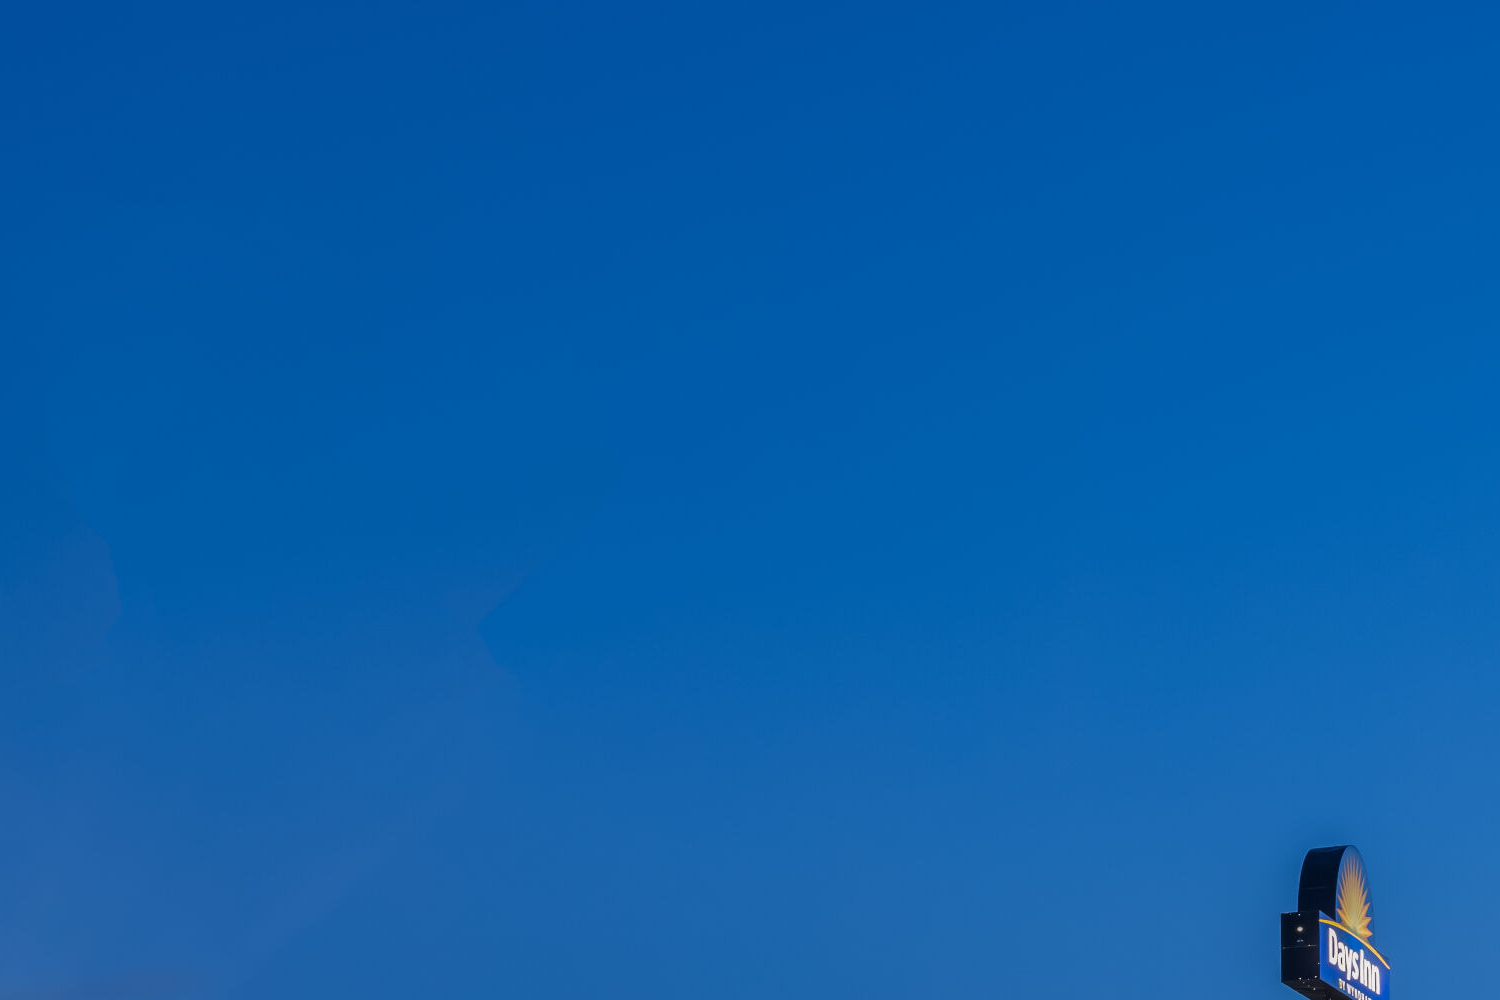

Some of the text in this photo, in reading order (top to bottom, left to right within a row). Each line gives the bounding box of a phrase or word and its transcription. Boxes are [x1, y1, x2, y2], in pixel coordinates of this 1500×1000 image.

[1328, 927, 1381, 995] Days Inn
[1338, 978, 1346, 991] BY
